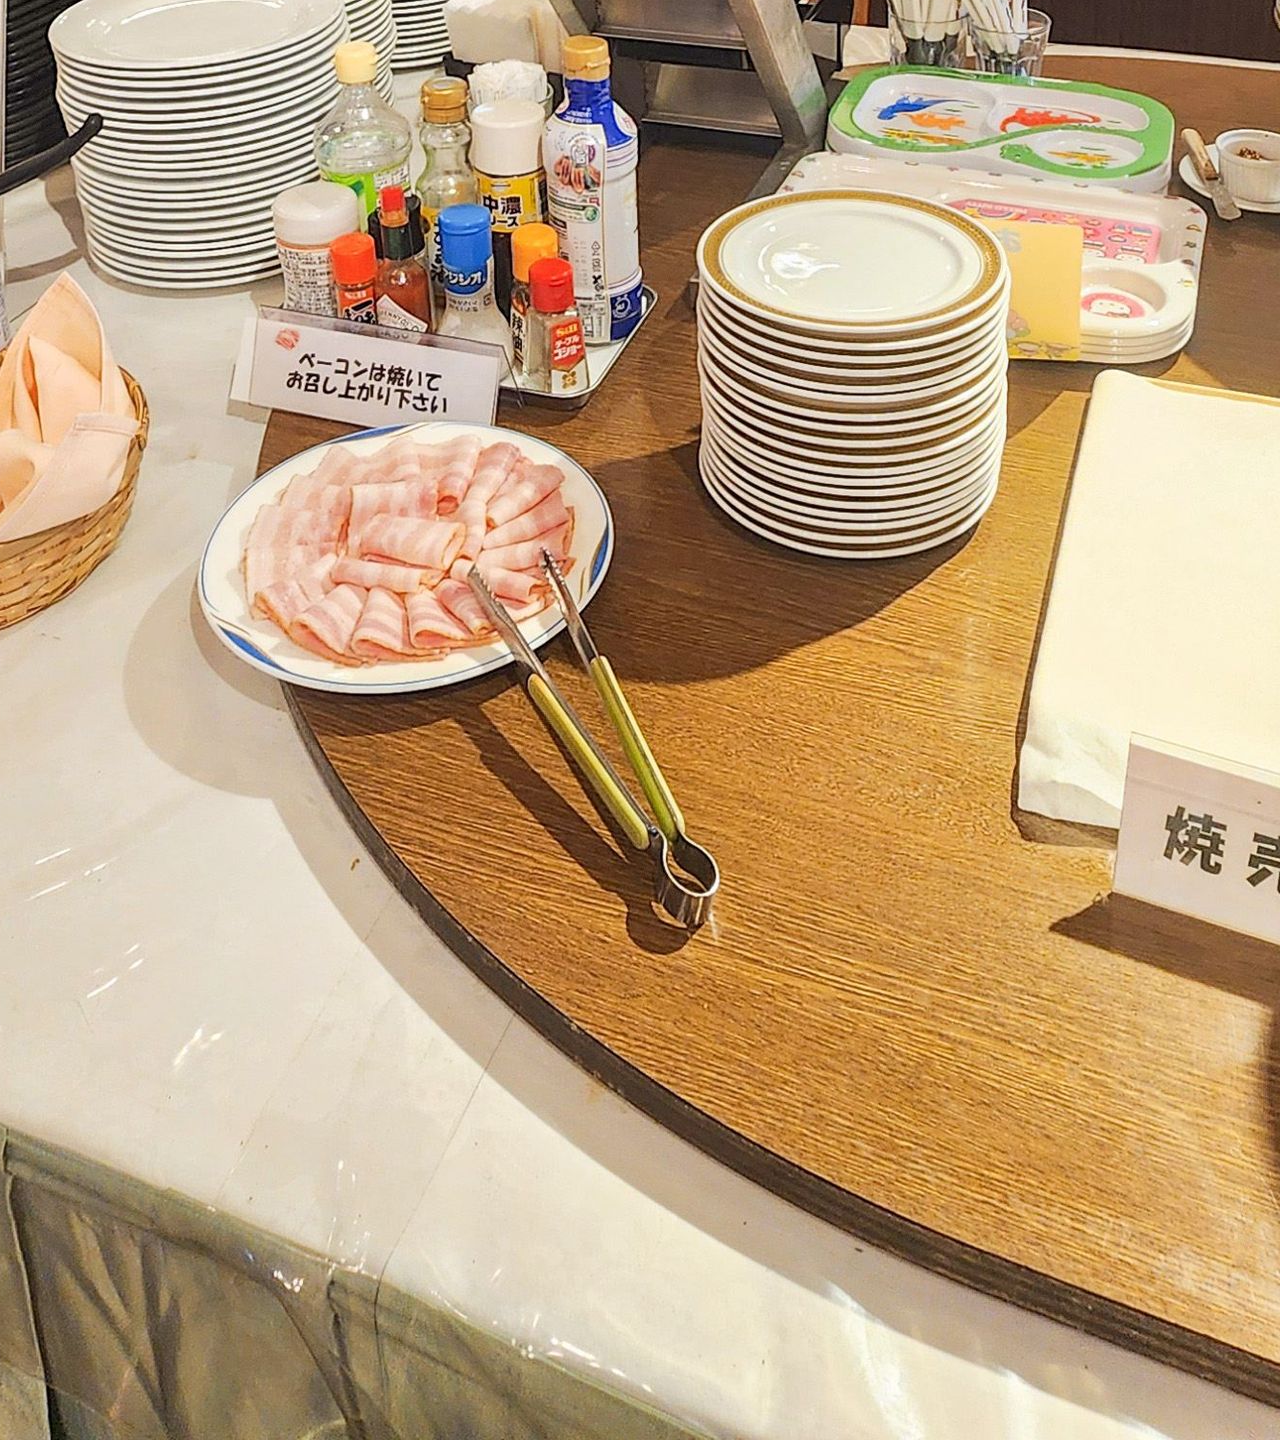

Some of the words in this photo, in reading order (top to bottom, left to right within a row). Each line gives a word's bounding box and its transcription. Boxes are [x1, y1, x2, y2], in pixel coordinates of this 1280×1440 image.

[483, 194, 521, 215] 中濃
[299, 353, 442, 391] ベーコンは焼いて
[286, 371, 448, 413] お召し上がり下さい
